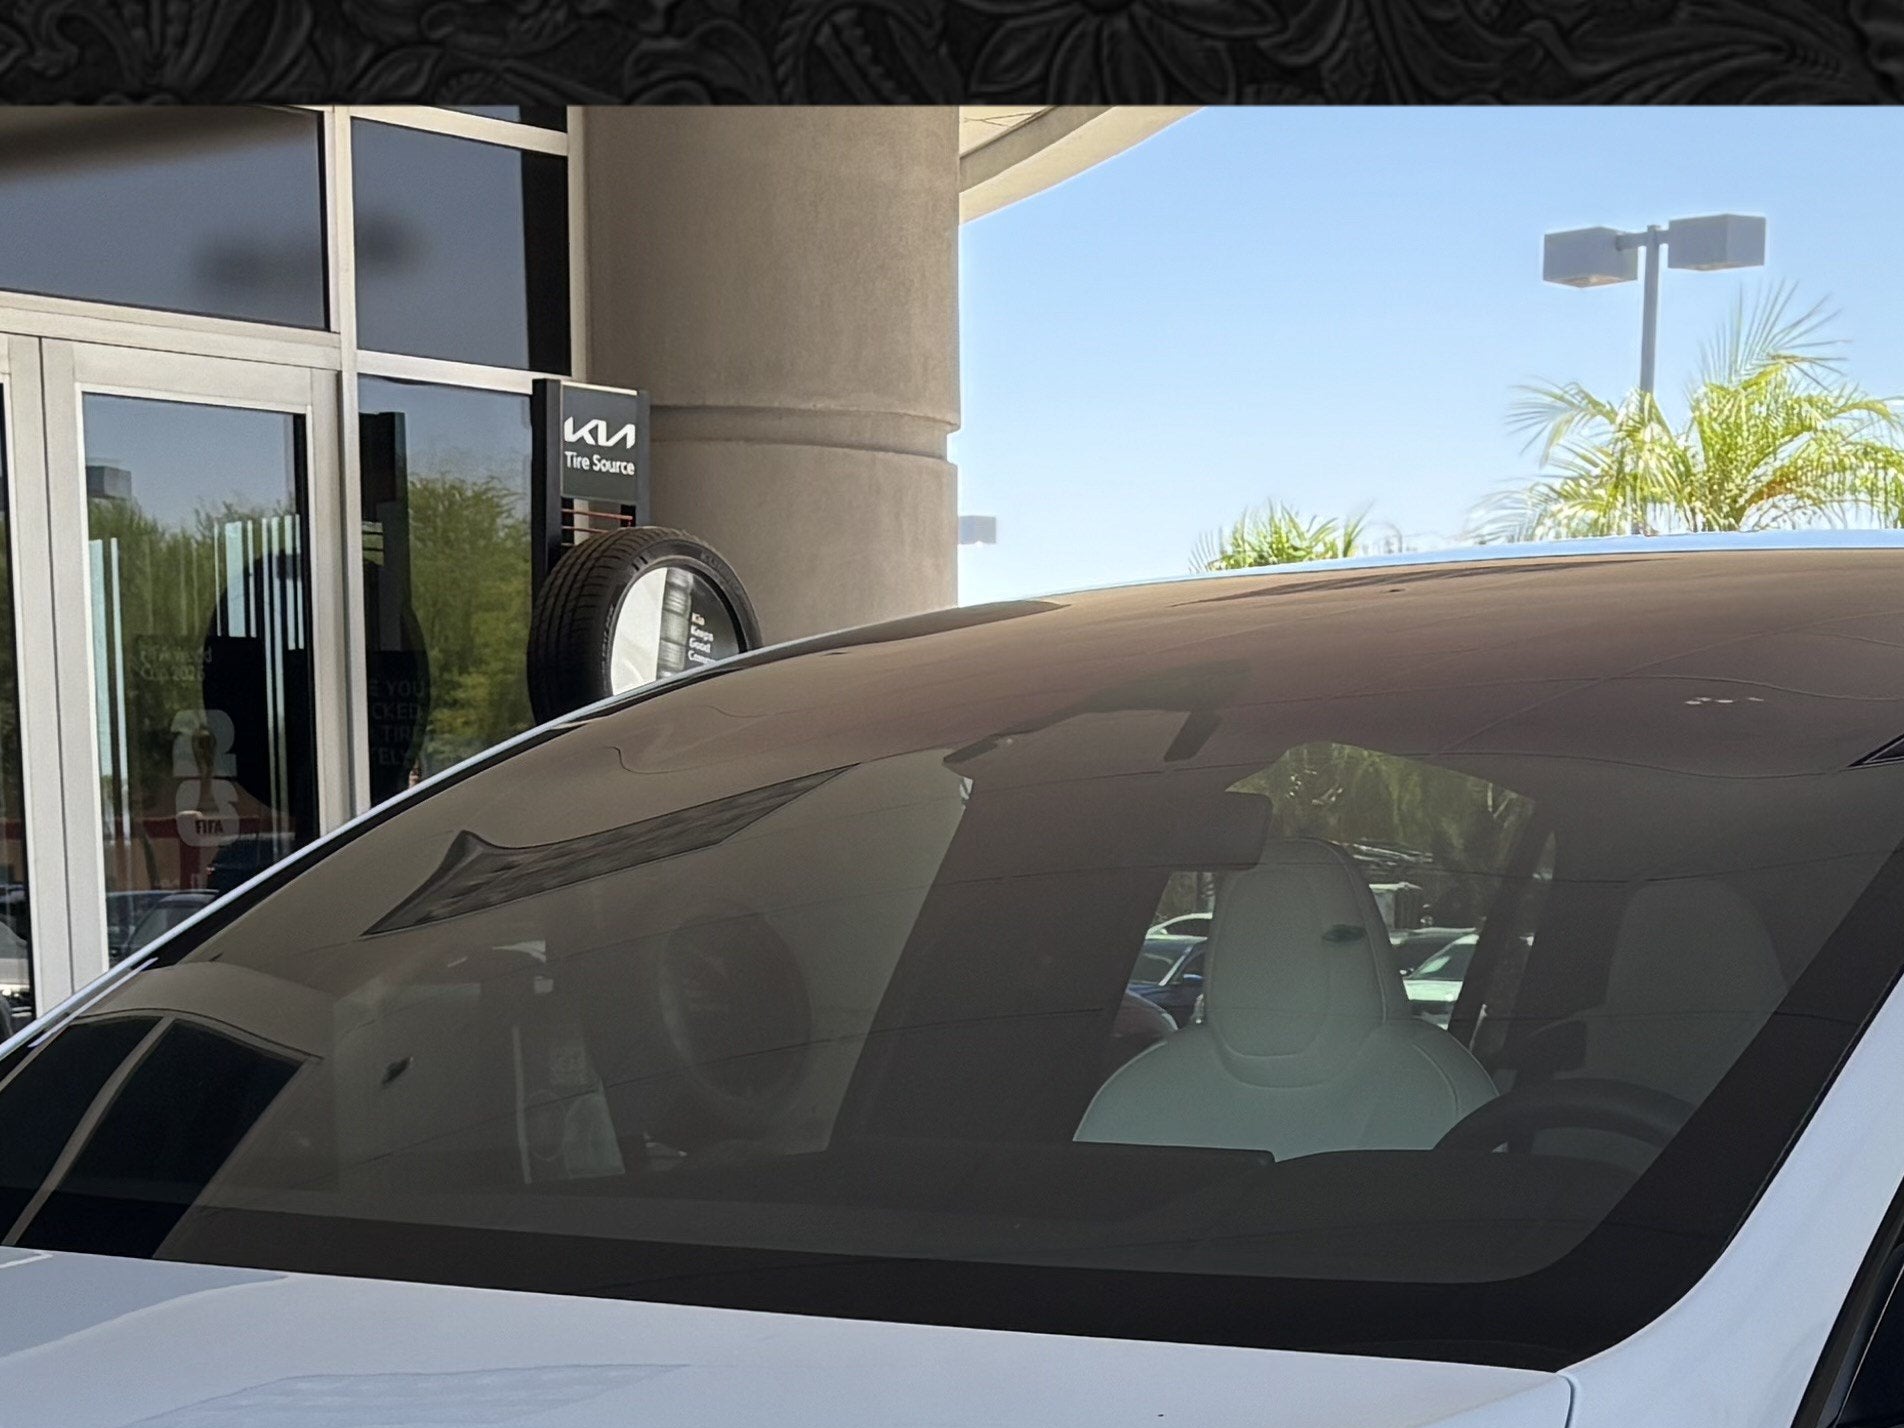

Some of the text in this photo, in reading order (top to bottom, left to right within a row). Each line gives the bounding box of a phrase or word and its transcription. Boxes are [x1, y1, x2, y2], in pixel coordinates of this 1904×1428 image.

[564, 416, 636, 449] KIA
[564, 451, 635, 475] Tire Source
[196, 818, 223, 836] FIFA
